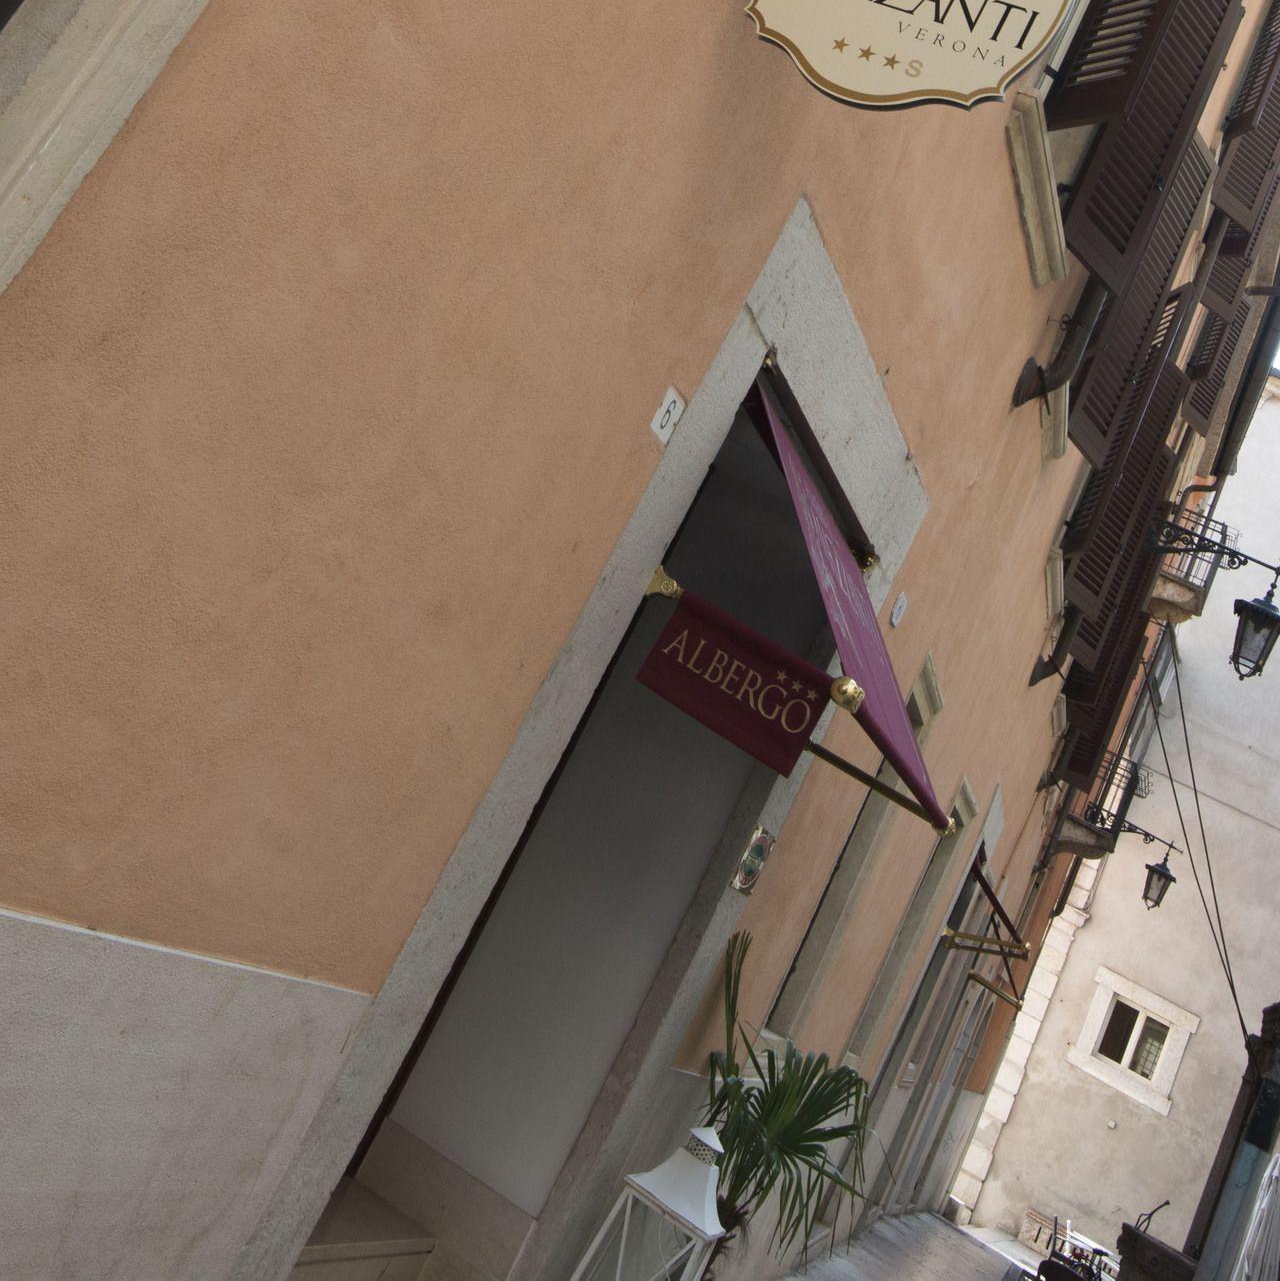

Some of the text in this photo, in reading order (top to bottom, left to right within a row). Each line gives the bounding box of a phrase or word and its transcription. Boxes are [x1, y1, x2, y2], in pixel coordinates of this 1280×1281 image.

[897, 21, 1007, 67] VERONA
[660, 399, 676, 430] 6
[662, 629, 811, 733] ALBERGO
